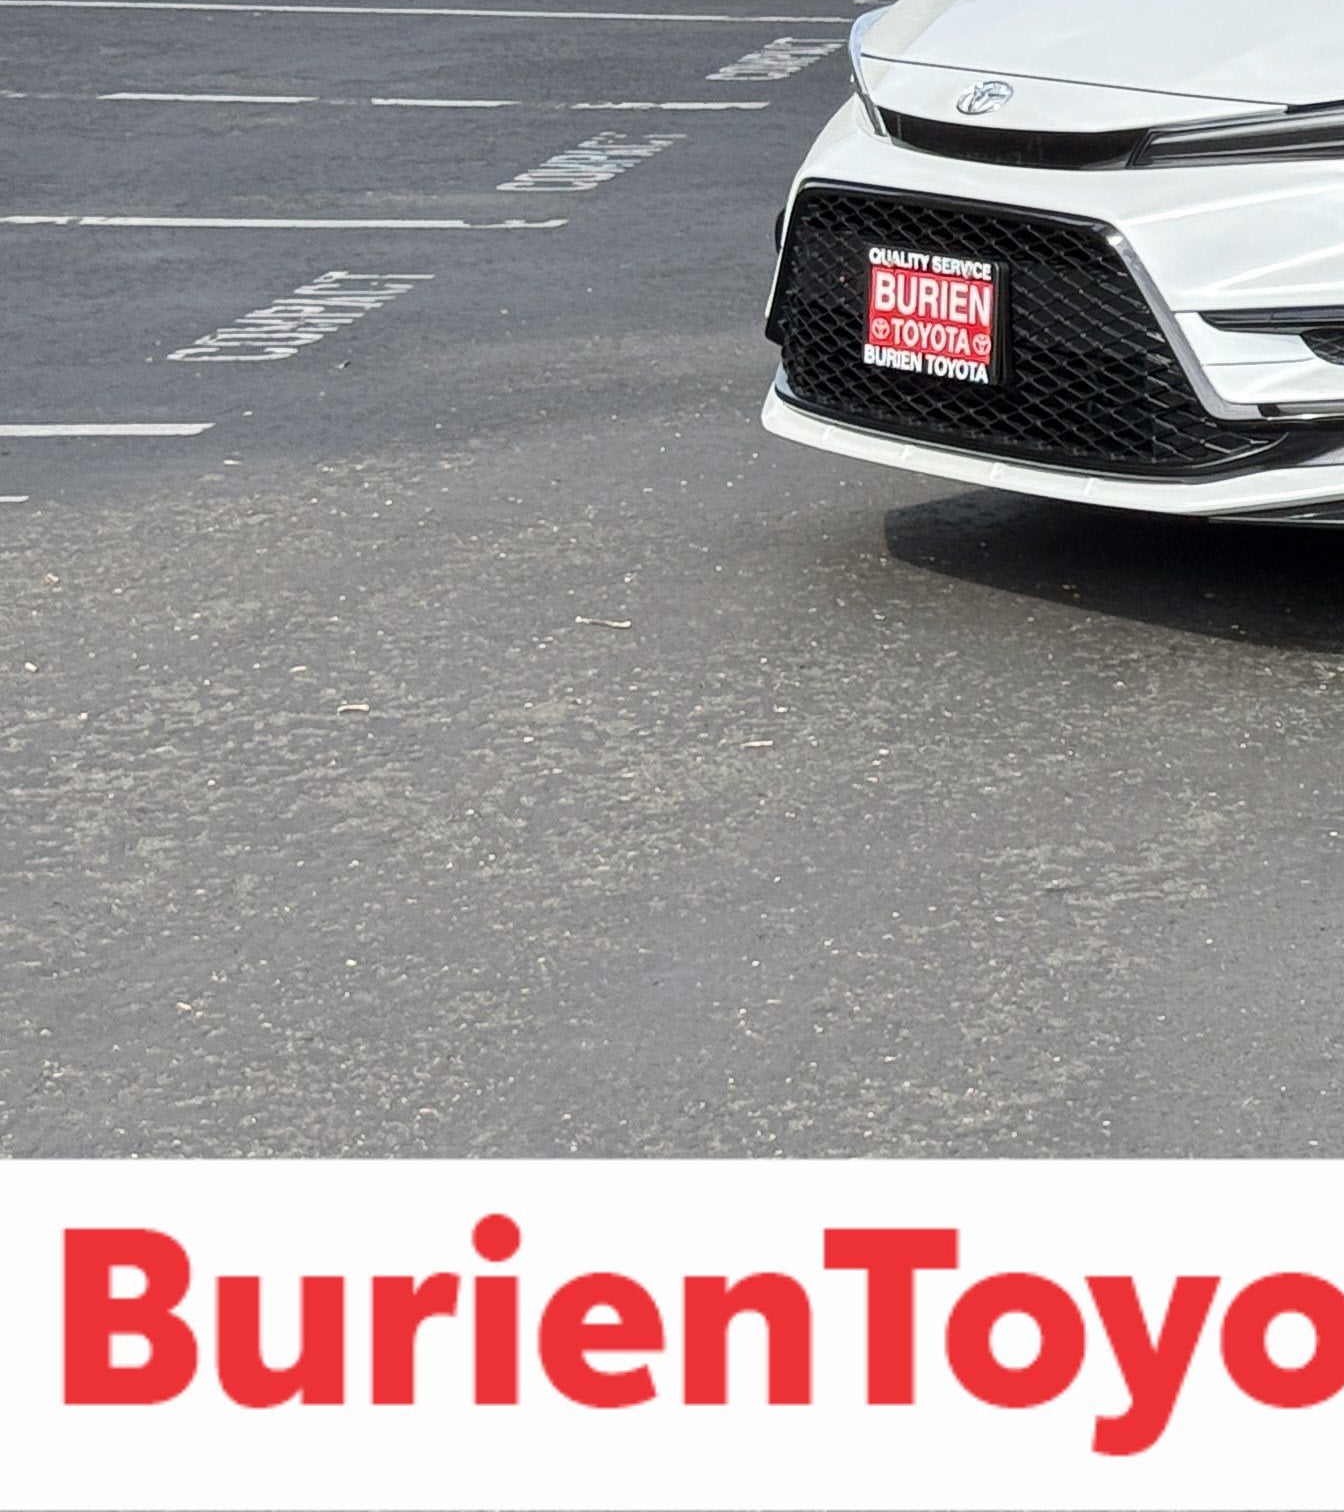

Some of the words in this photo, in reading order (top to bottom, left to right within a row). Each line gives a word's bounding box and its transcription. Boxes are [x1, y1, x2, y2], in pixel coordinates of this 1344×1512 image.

[868, 247, 930, 271] QUALITY
[931, 255, 992, 281] SERVICE
[873, 270, 992, 327] BURIEN
[890, 317, 972, 356] TOYOTA
[863, 343, 923, 373] BURIEN
[924, 354, 989, 385] TOYOTA
